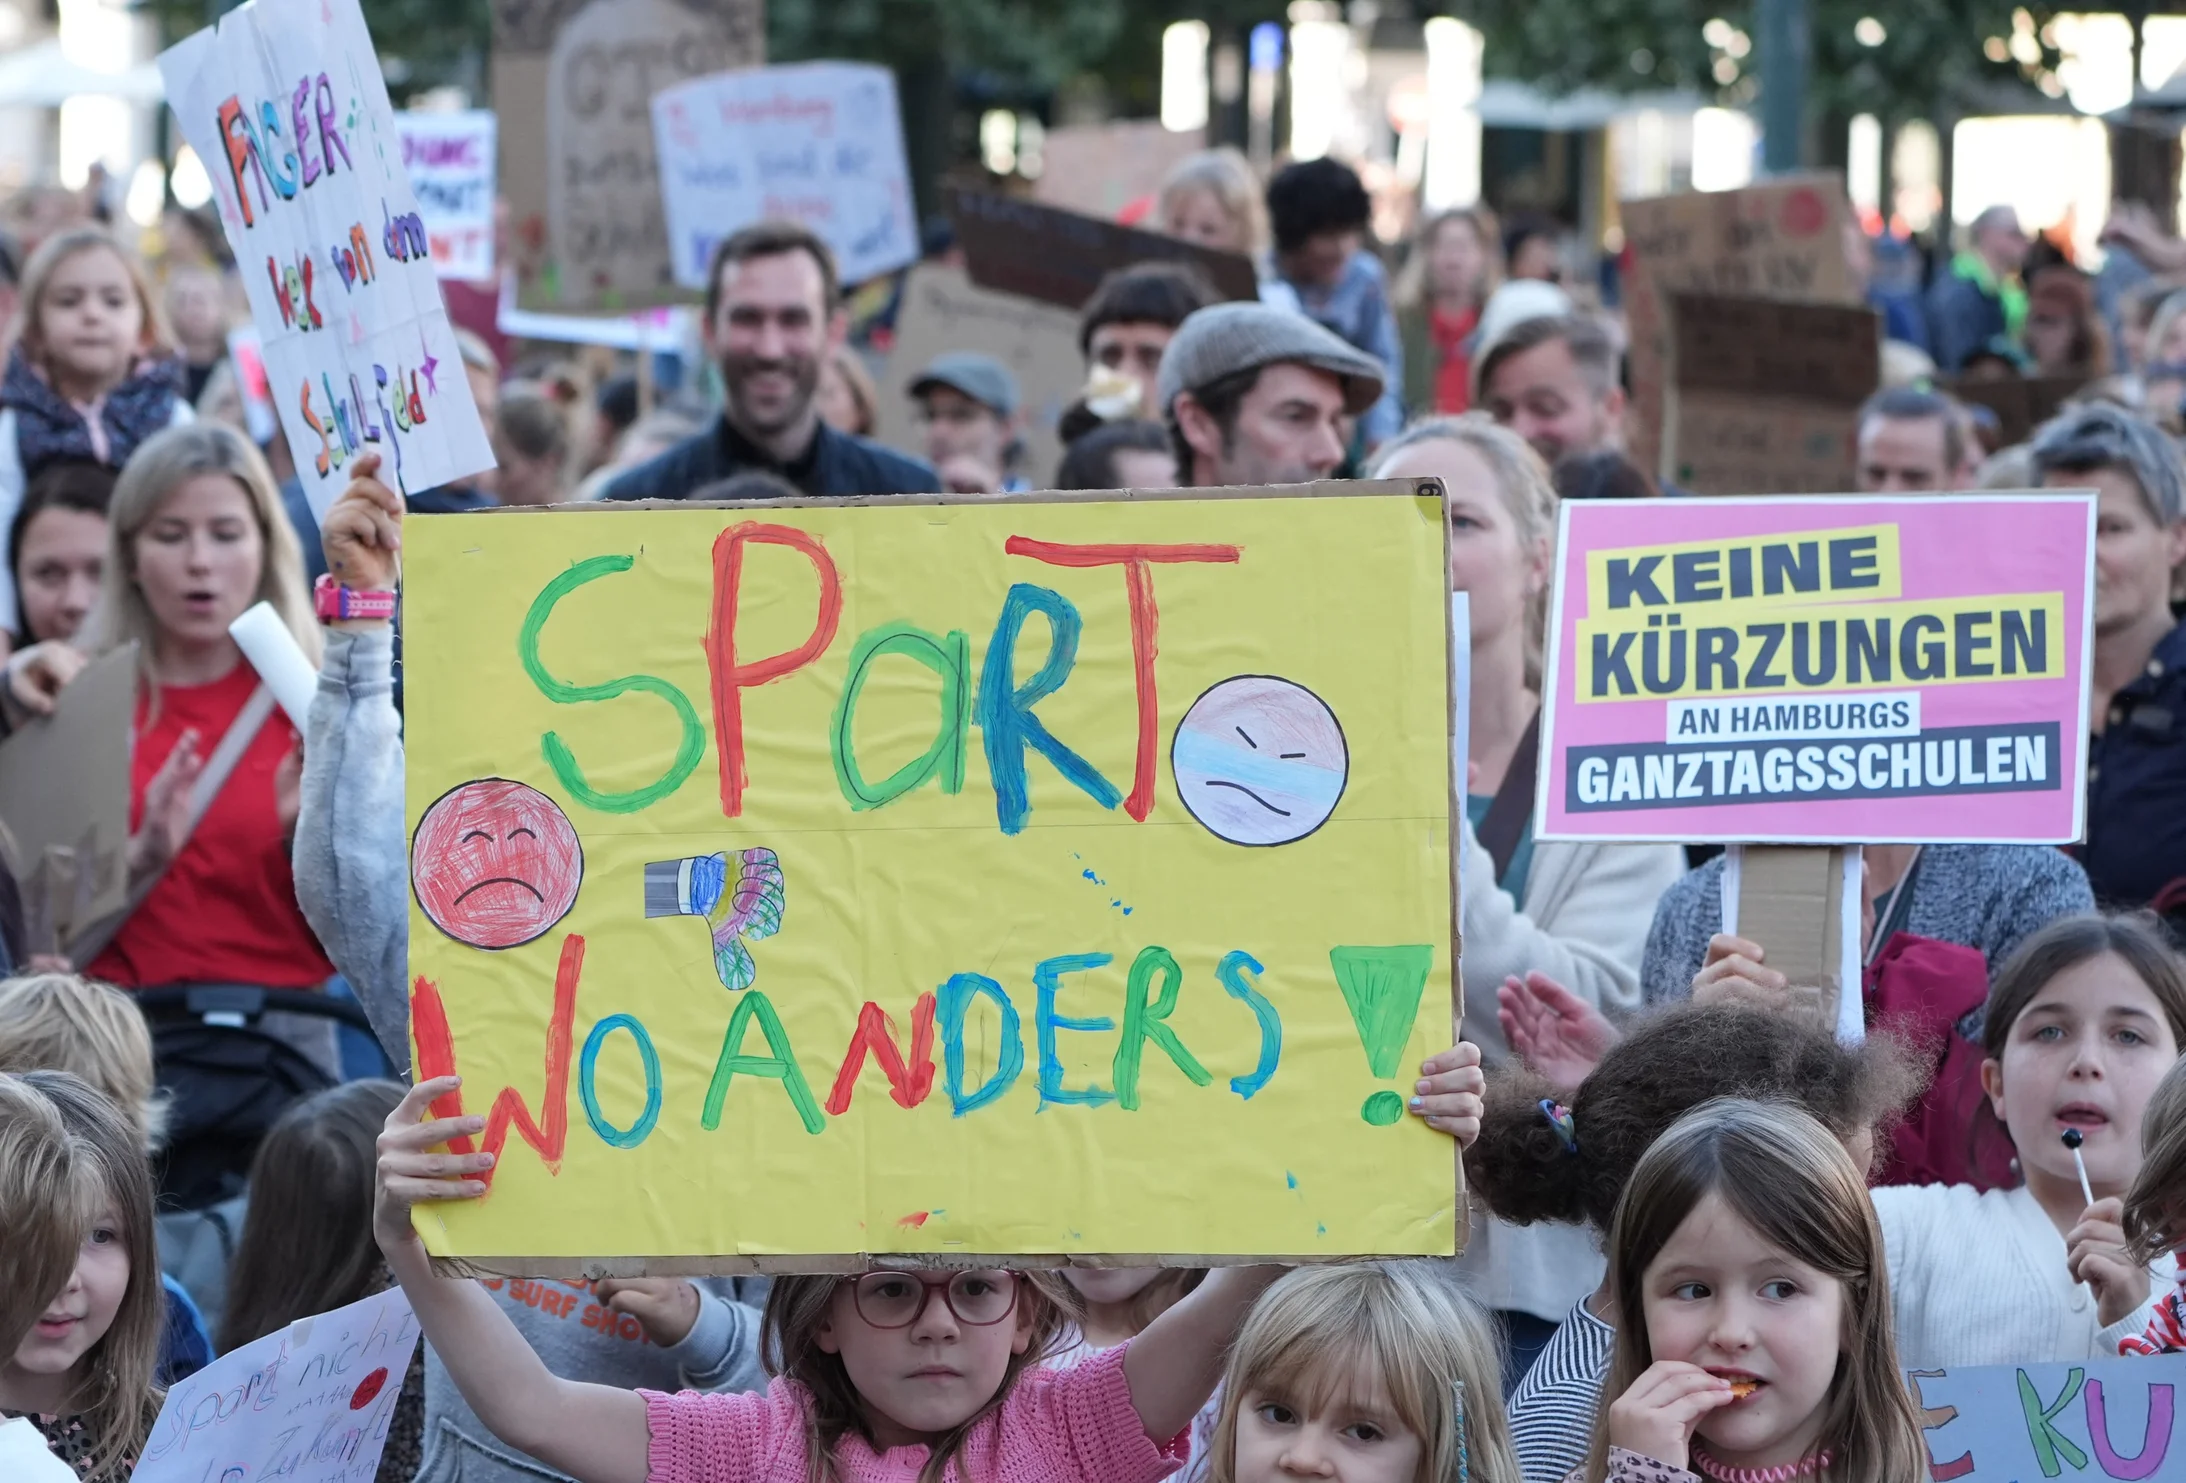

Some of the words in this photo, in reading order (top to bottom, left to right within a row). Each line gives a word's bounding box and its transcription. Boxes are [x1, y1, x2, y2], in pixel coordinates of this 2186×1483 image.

[1607, 536, 1880, 609] KEINE
[1591, 608, 2048, 697] KÜRZUNGEN
[1678, 709, 1720, 735] AN
[1731, 701, 1910, 733] HAMBURGS
[1577, 736, 2047, 804] GANZTAGSSCHULEN
[298, 1304, 412, 1387] nicht
[508, 1278, 579, 1319] SURF
[580, 1303, 651, 1345] SHO
